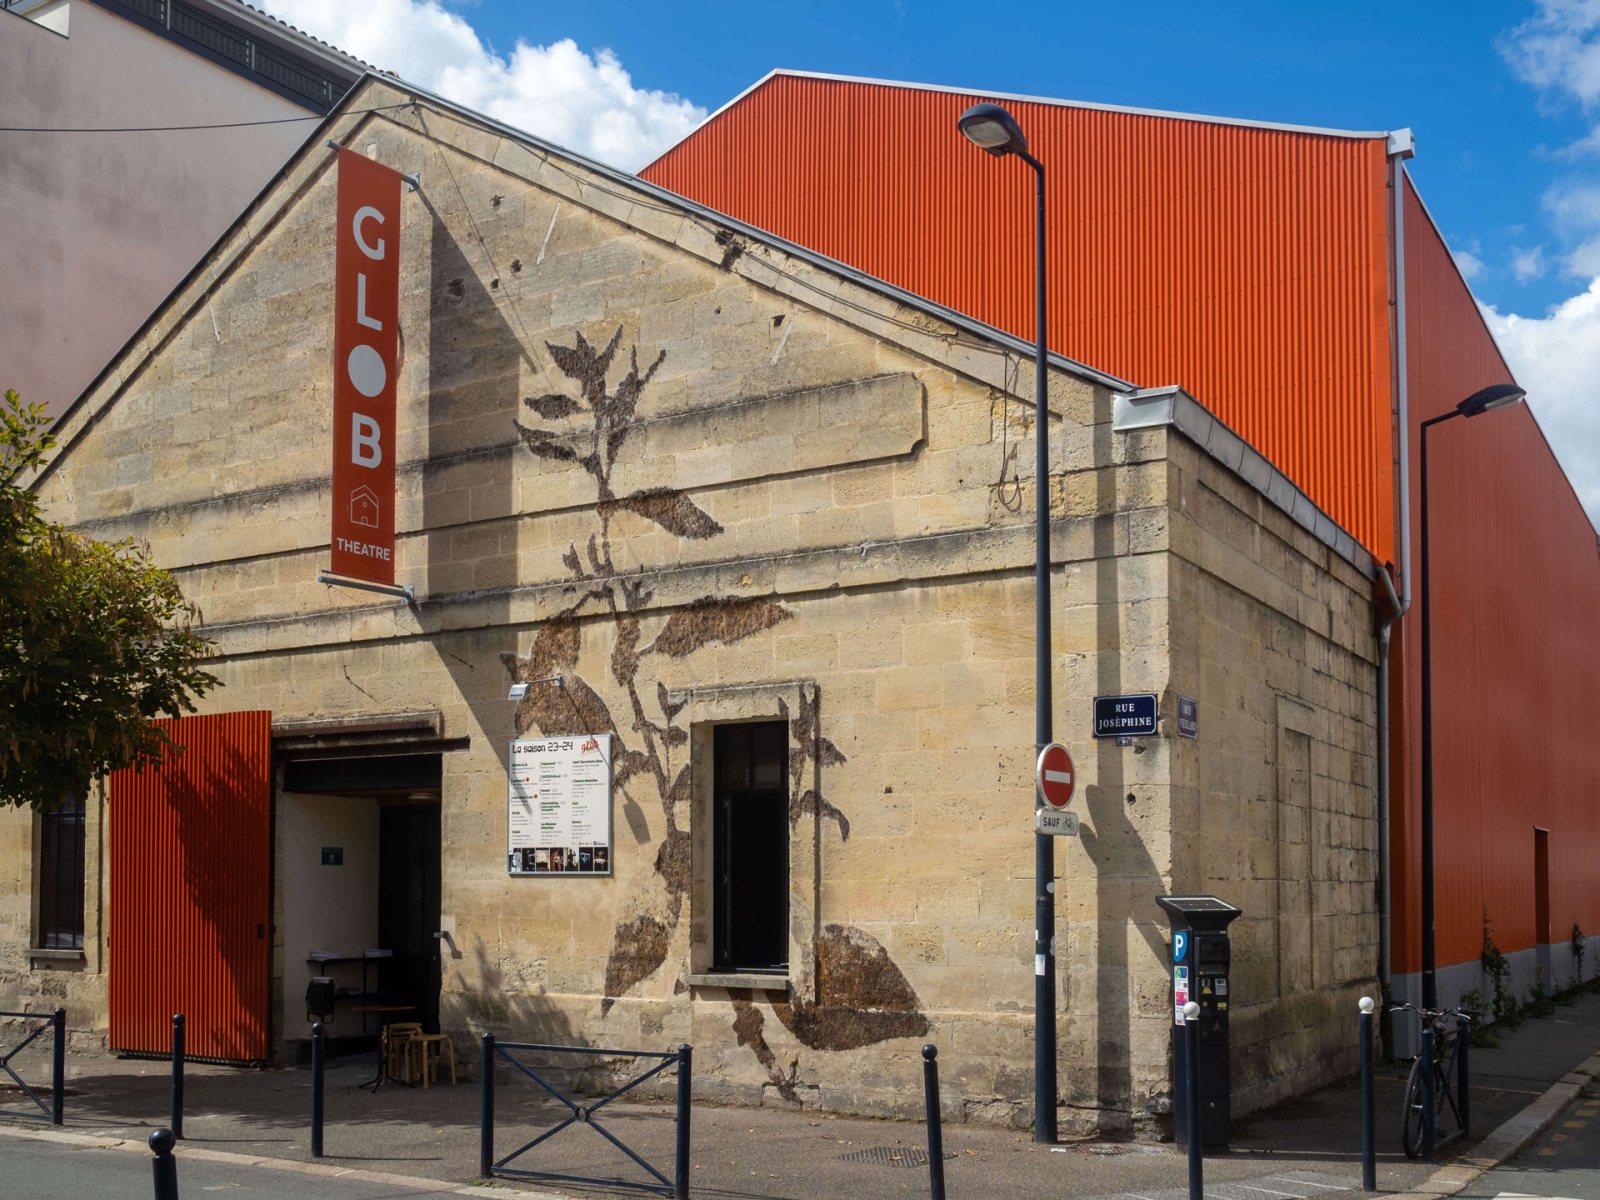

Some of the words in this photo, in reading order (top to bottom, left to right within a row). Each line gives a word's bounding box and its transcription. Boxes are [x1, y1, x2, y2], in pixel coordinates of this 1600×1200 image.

[336, 537, 391, 561] THEATRE
[1115, 703, 1135, 713] RUE
[1098, 716, 1152, 730] JOSÉPHINE
[512, 744, 521, 753] La
[523, 743, 546, 753] saison
[1043, 816, 1061, 828] SAUF
[1175, 934, 1184, 957] P
